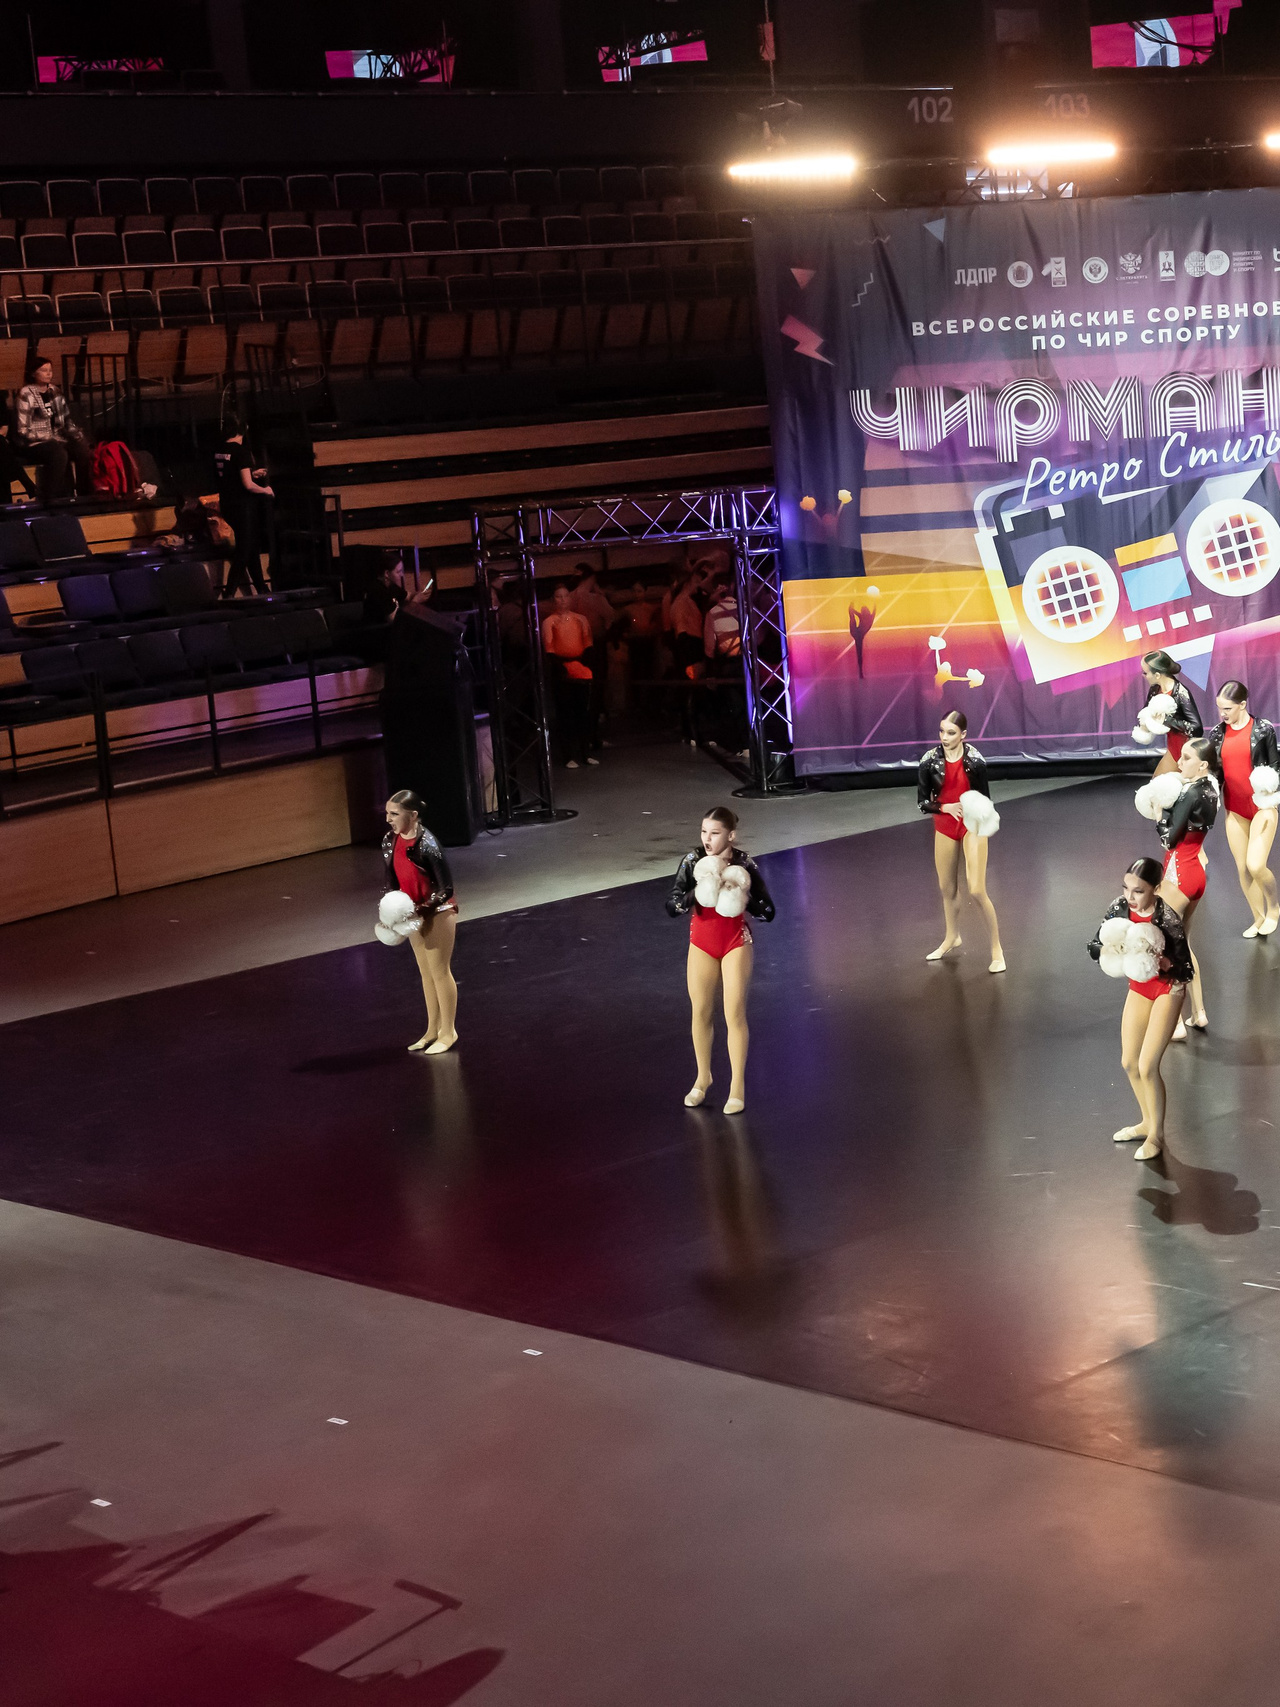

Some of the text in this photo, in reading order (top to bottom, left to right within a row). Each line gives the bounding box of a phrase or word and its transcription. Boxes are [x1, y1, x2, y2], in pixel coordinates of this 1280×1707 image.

[907, 96, 954, 124] 102
[1044, 93, 1091, 119] 103
[954, 267, 998, 287] ЛДПР
[911, 309, 1135, 337] ВСЕРОССИЙСКИЕ
[1032, 324, 1242, 351] ПО ЧИР СПОРТУ
[1021, 456, 1143, 505] Ретро
